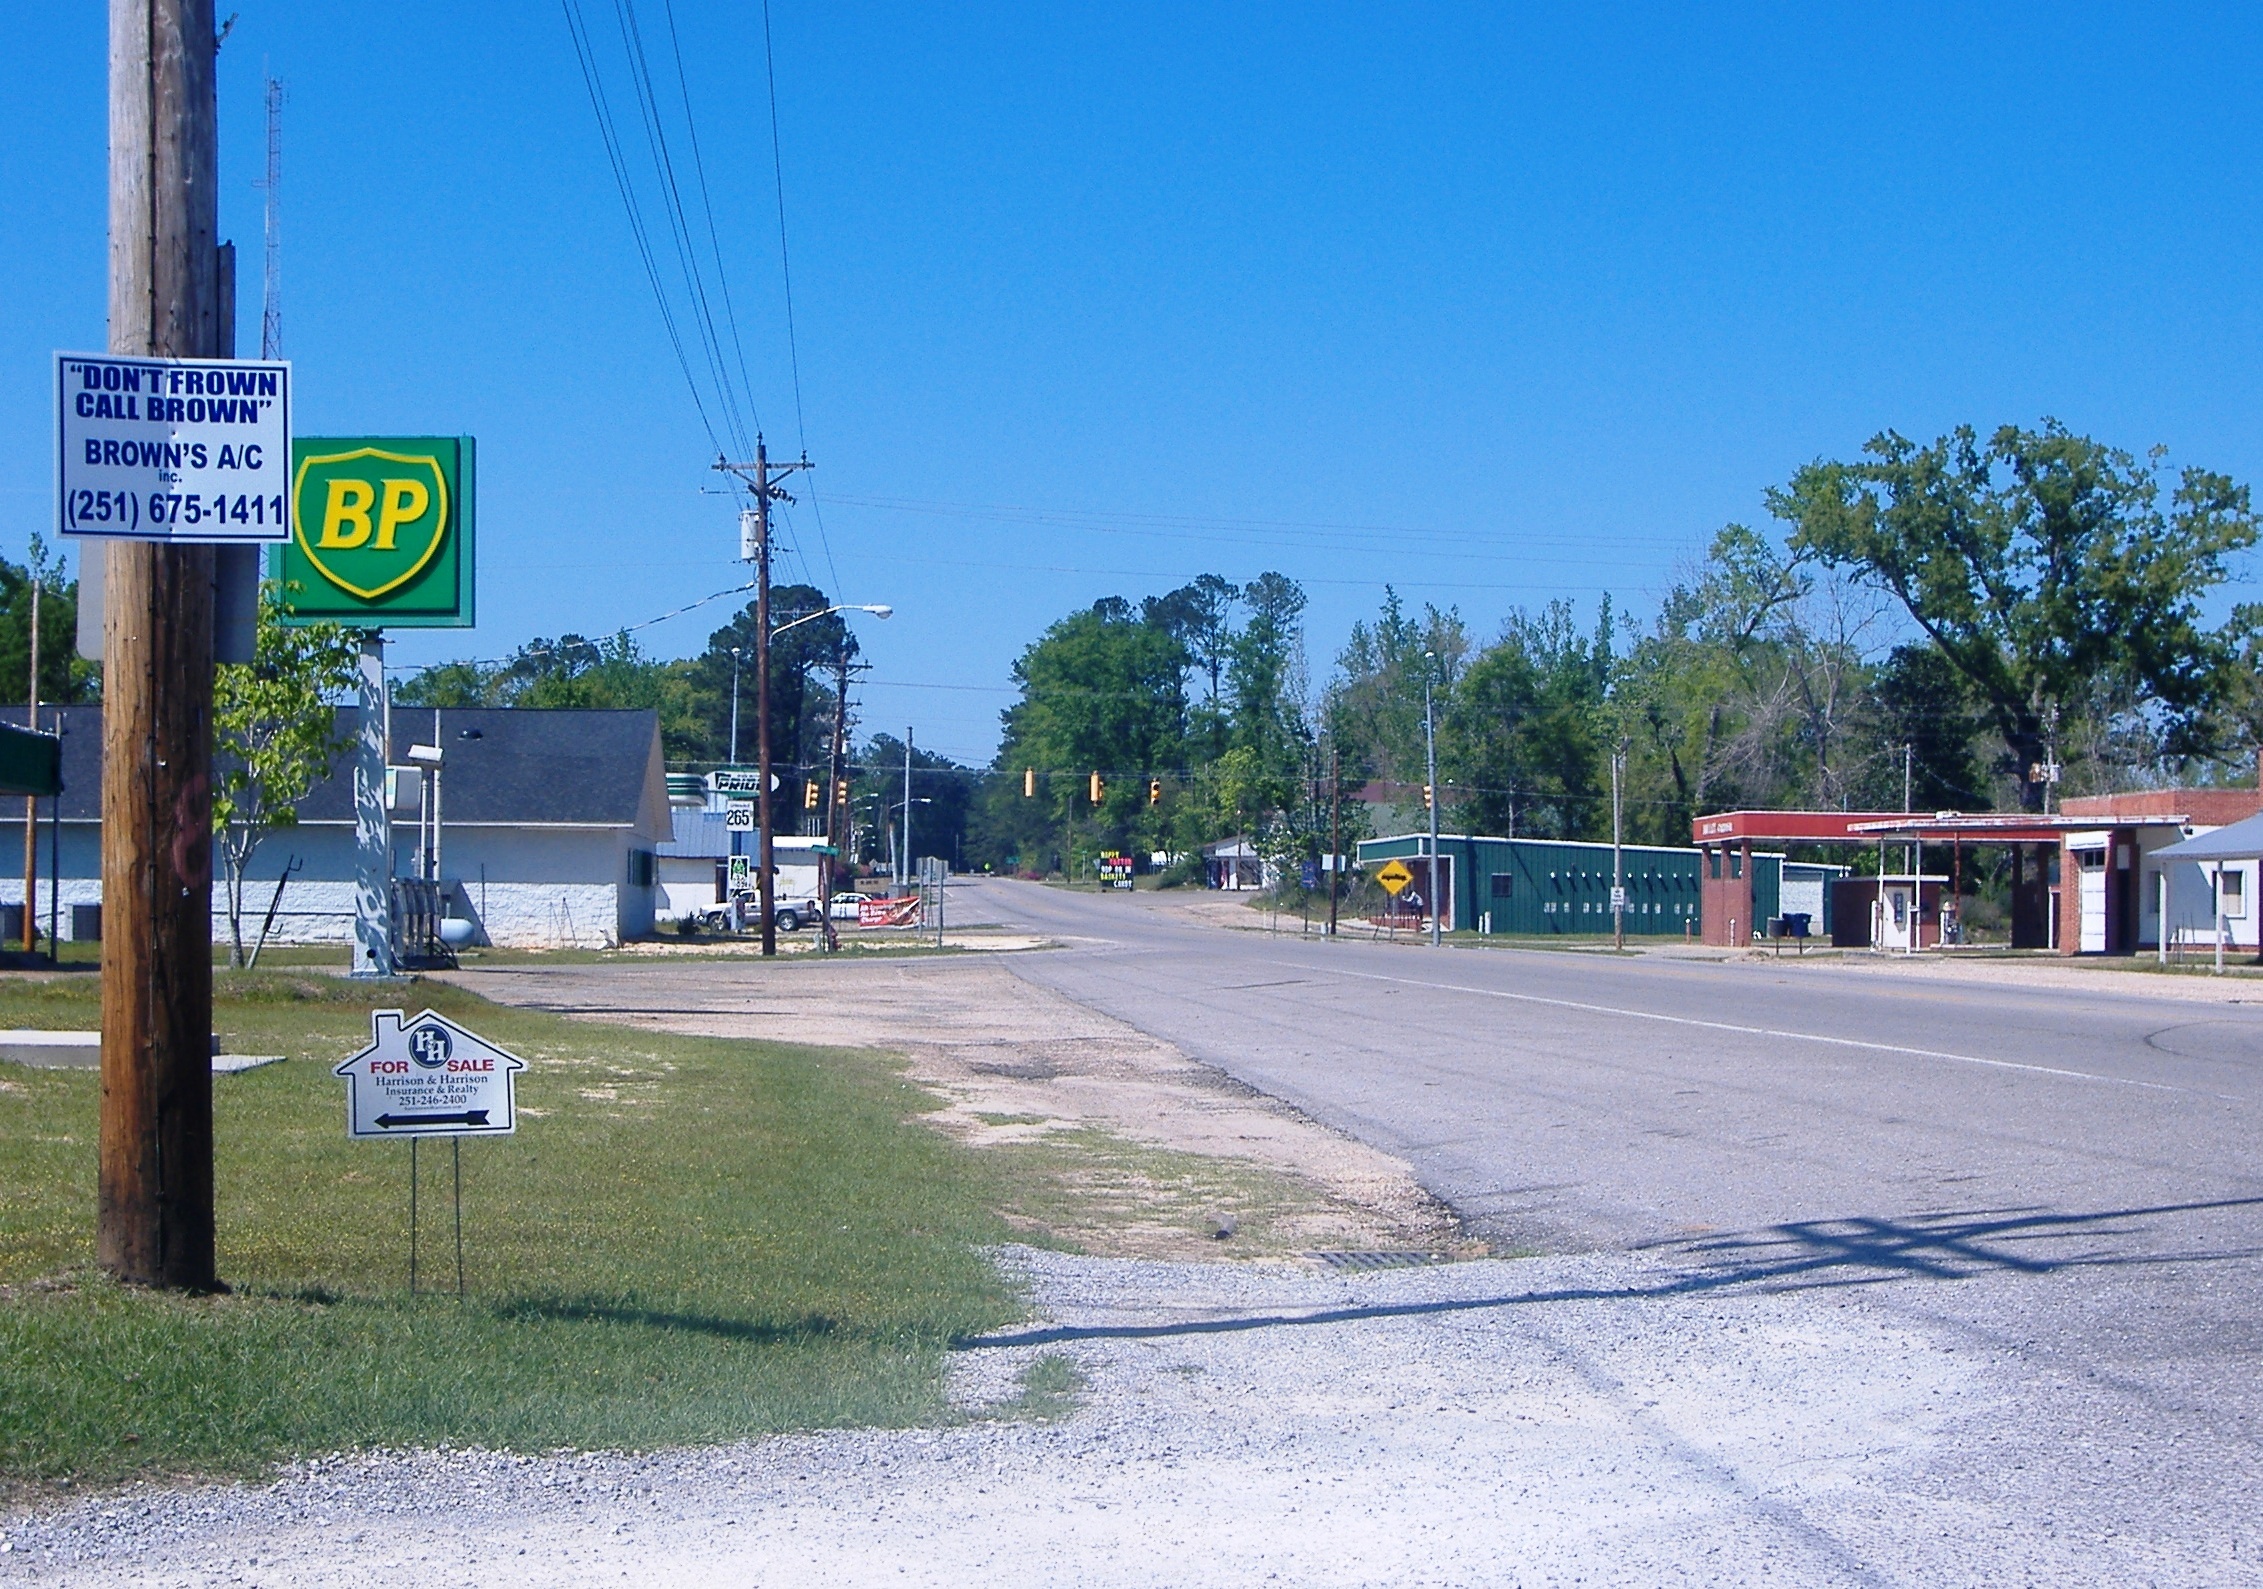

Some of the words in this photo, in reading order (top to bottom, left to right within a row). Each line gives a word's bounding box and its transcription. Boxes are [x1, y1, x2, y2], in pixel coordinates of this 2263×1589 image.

[170, 370, 277, 397] FROWN
[76, 392, 139, 420] CALL
[85, 439, 208, 470] BROWN'S
[217, 444, 264, 470] A/C
[158, 469, 183, 483] inc.
[68, 489, 139, 530] (251)
[149, 494, 283, 525] 675-1411
[315, 478, 430, 550] BP
[726, 808, 750, 825] 265
[370, 1061, 409, 1074] FOR
[447, 1059, 495, 1073] SALE
[376, 1075, 424, 1087] Harrison
[427, 1075, 437, 1085] &
[440, 1074, 488, 1084] Harrison
[386, 1086, 435, 1096] Insurance
[437, 1085, 447, 1095] &
[448, 1084, 479, 1096] Realty
[399, 1095, 467, 1106] 251-246-2400
